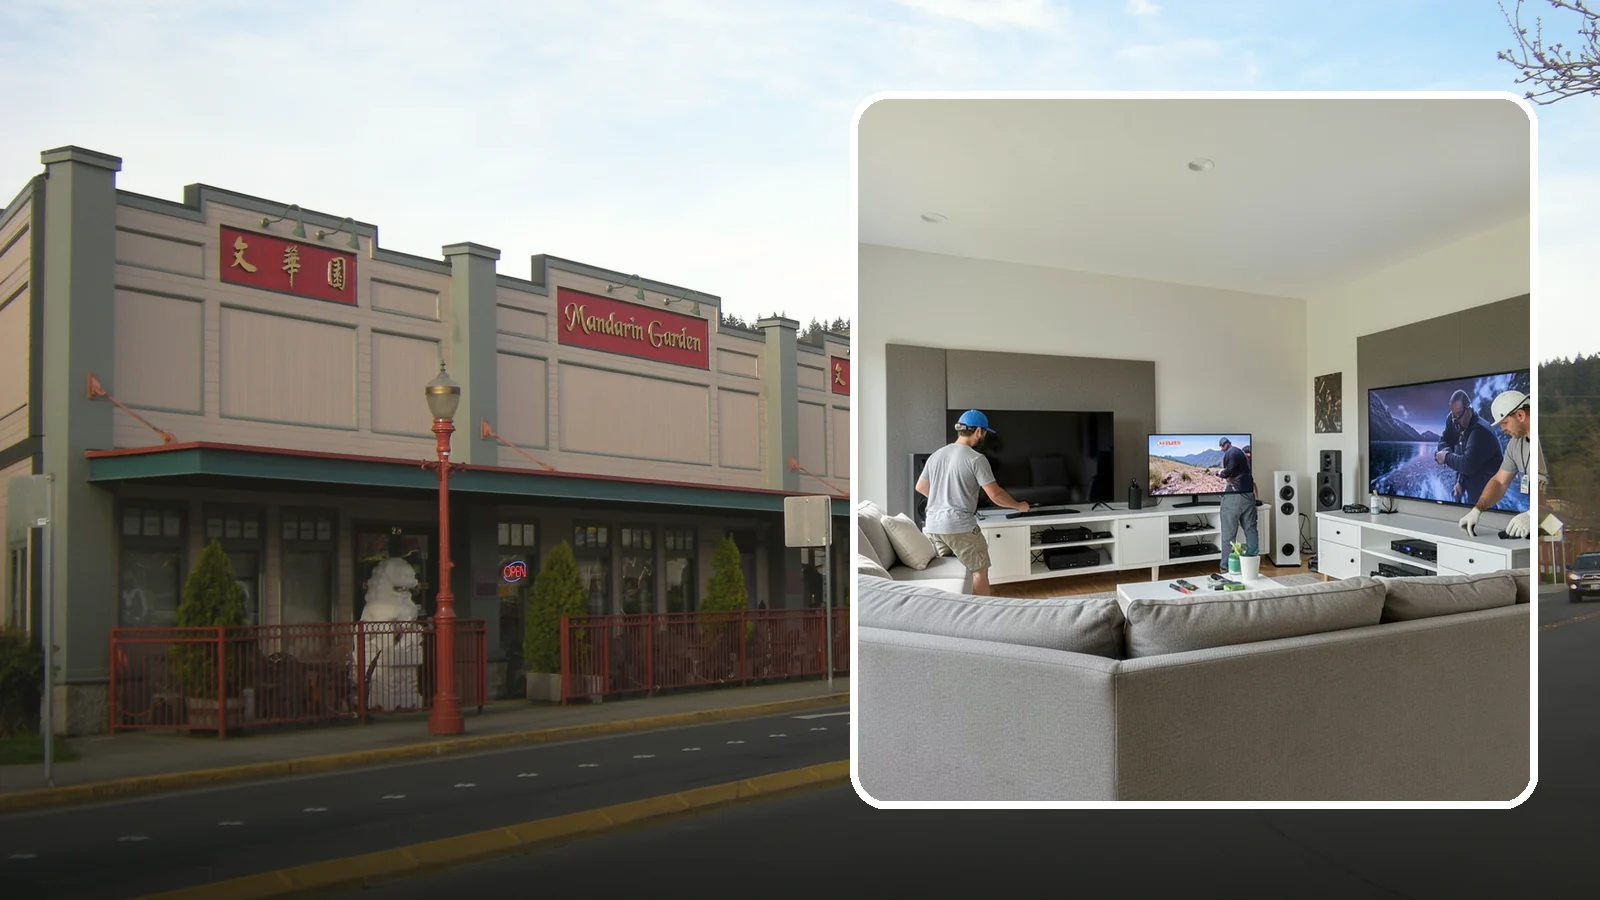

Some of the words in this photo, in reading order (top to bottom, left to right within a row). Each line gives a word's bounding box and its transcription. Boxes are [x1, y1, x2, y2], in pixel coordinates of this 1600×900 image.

[230, 235, 346, 291] 文華園
[564, 302, 643, 341] Mandarin
[648, 320, 701, 352] Garden
[503, 565, 526, 578] OPEN
